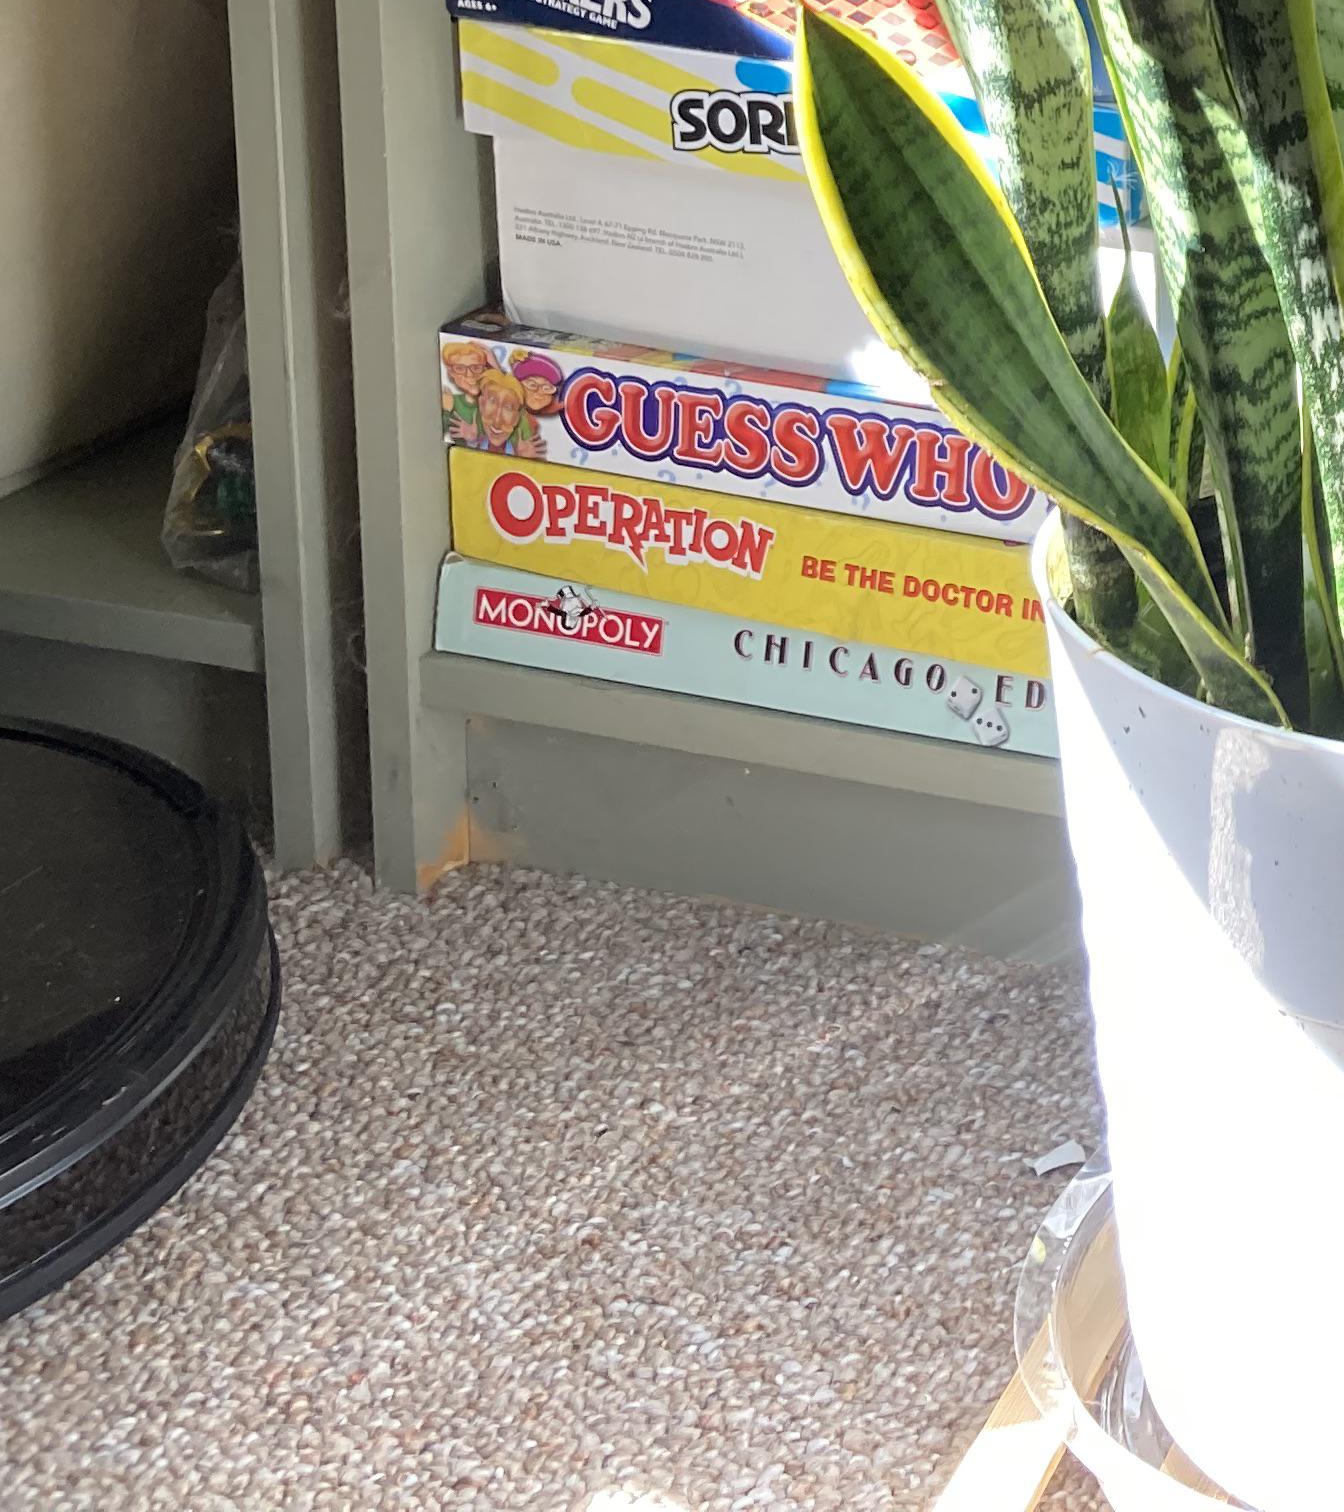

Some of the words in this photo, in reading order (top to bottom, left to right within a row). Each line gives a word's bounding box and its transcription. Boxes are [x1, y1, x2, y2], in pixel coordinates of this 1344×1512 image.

[589, 12, 618, 31] GAME
[564, 372, 821, 482] GUESS
[826, 414, 1030, 515] WHO
[490, 471, 775, 574] OPERATION
[477, 593, 660, 650] MONOPOLY
[801, 555, 837, 582] BE
[844, 563, 896, 594] THE
[903, 575, 1013, 618] DOCTOR
[734, 629, 947, 694] CHICAGO
[994, 674, 1046, 710] ED
